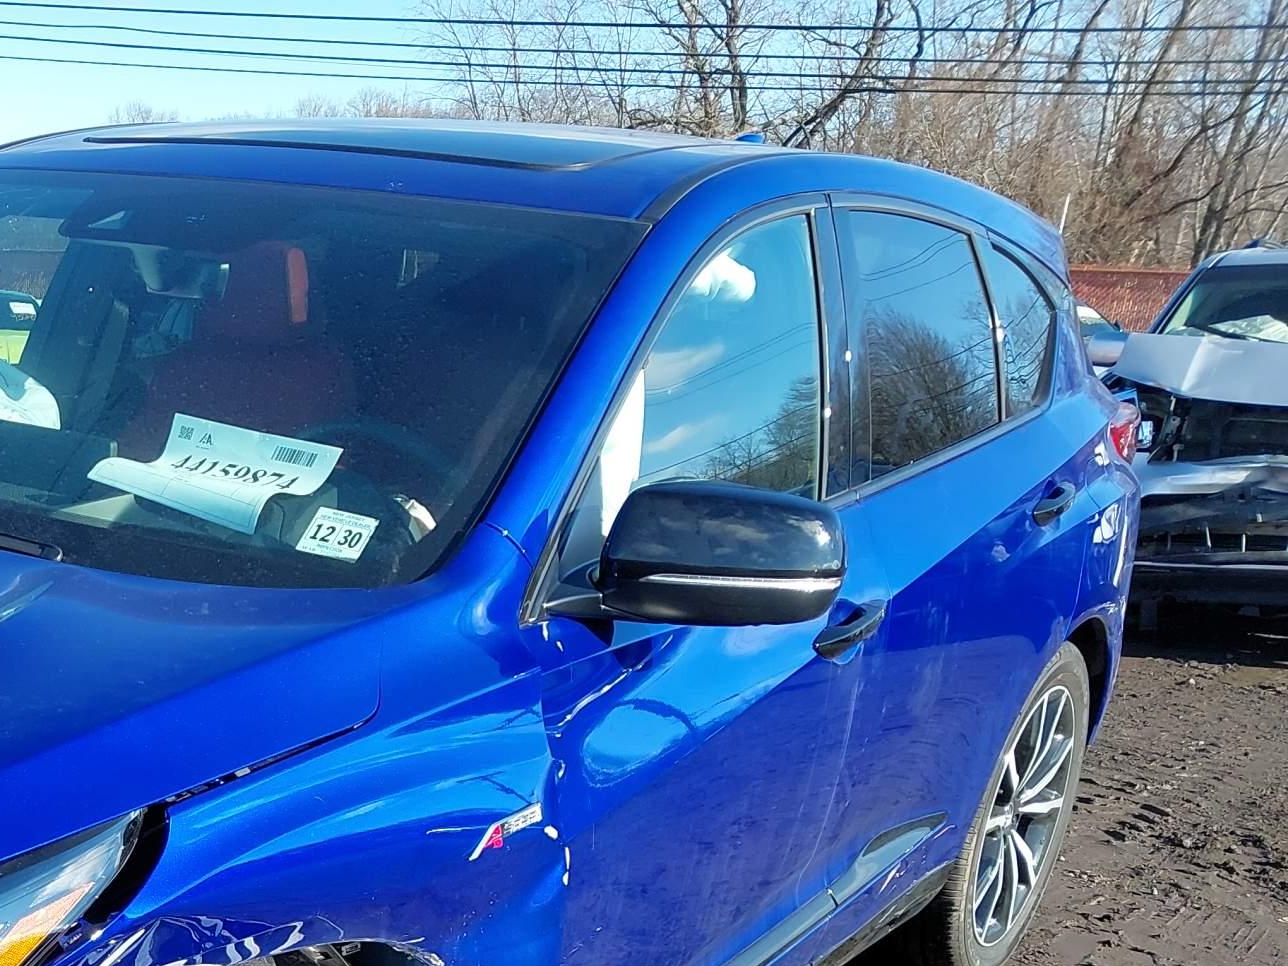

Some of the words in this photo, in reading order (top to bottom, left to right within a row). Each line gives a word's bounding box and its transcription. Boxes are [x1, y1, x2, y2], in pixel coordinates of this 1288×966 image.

[170, 455, 300, 489] 44159874
[309, 523, 337, 543] 12
[337, 529, 363, 549] 30
